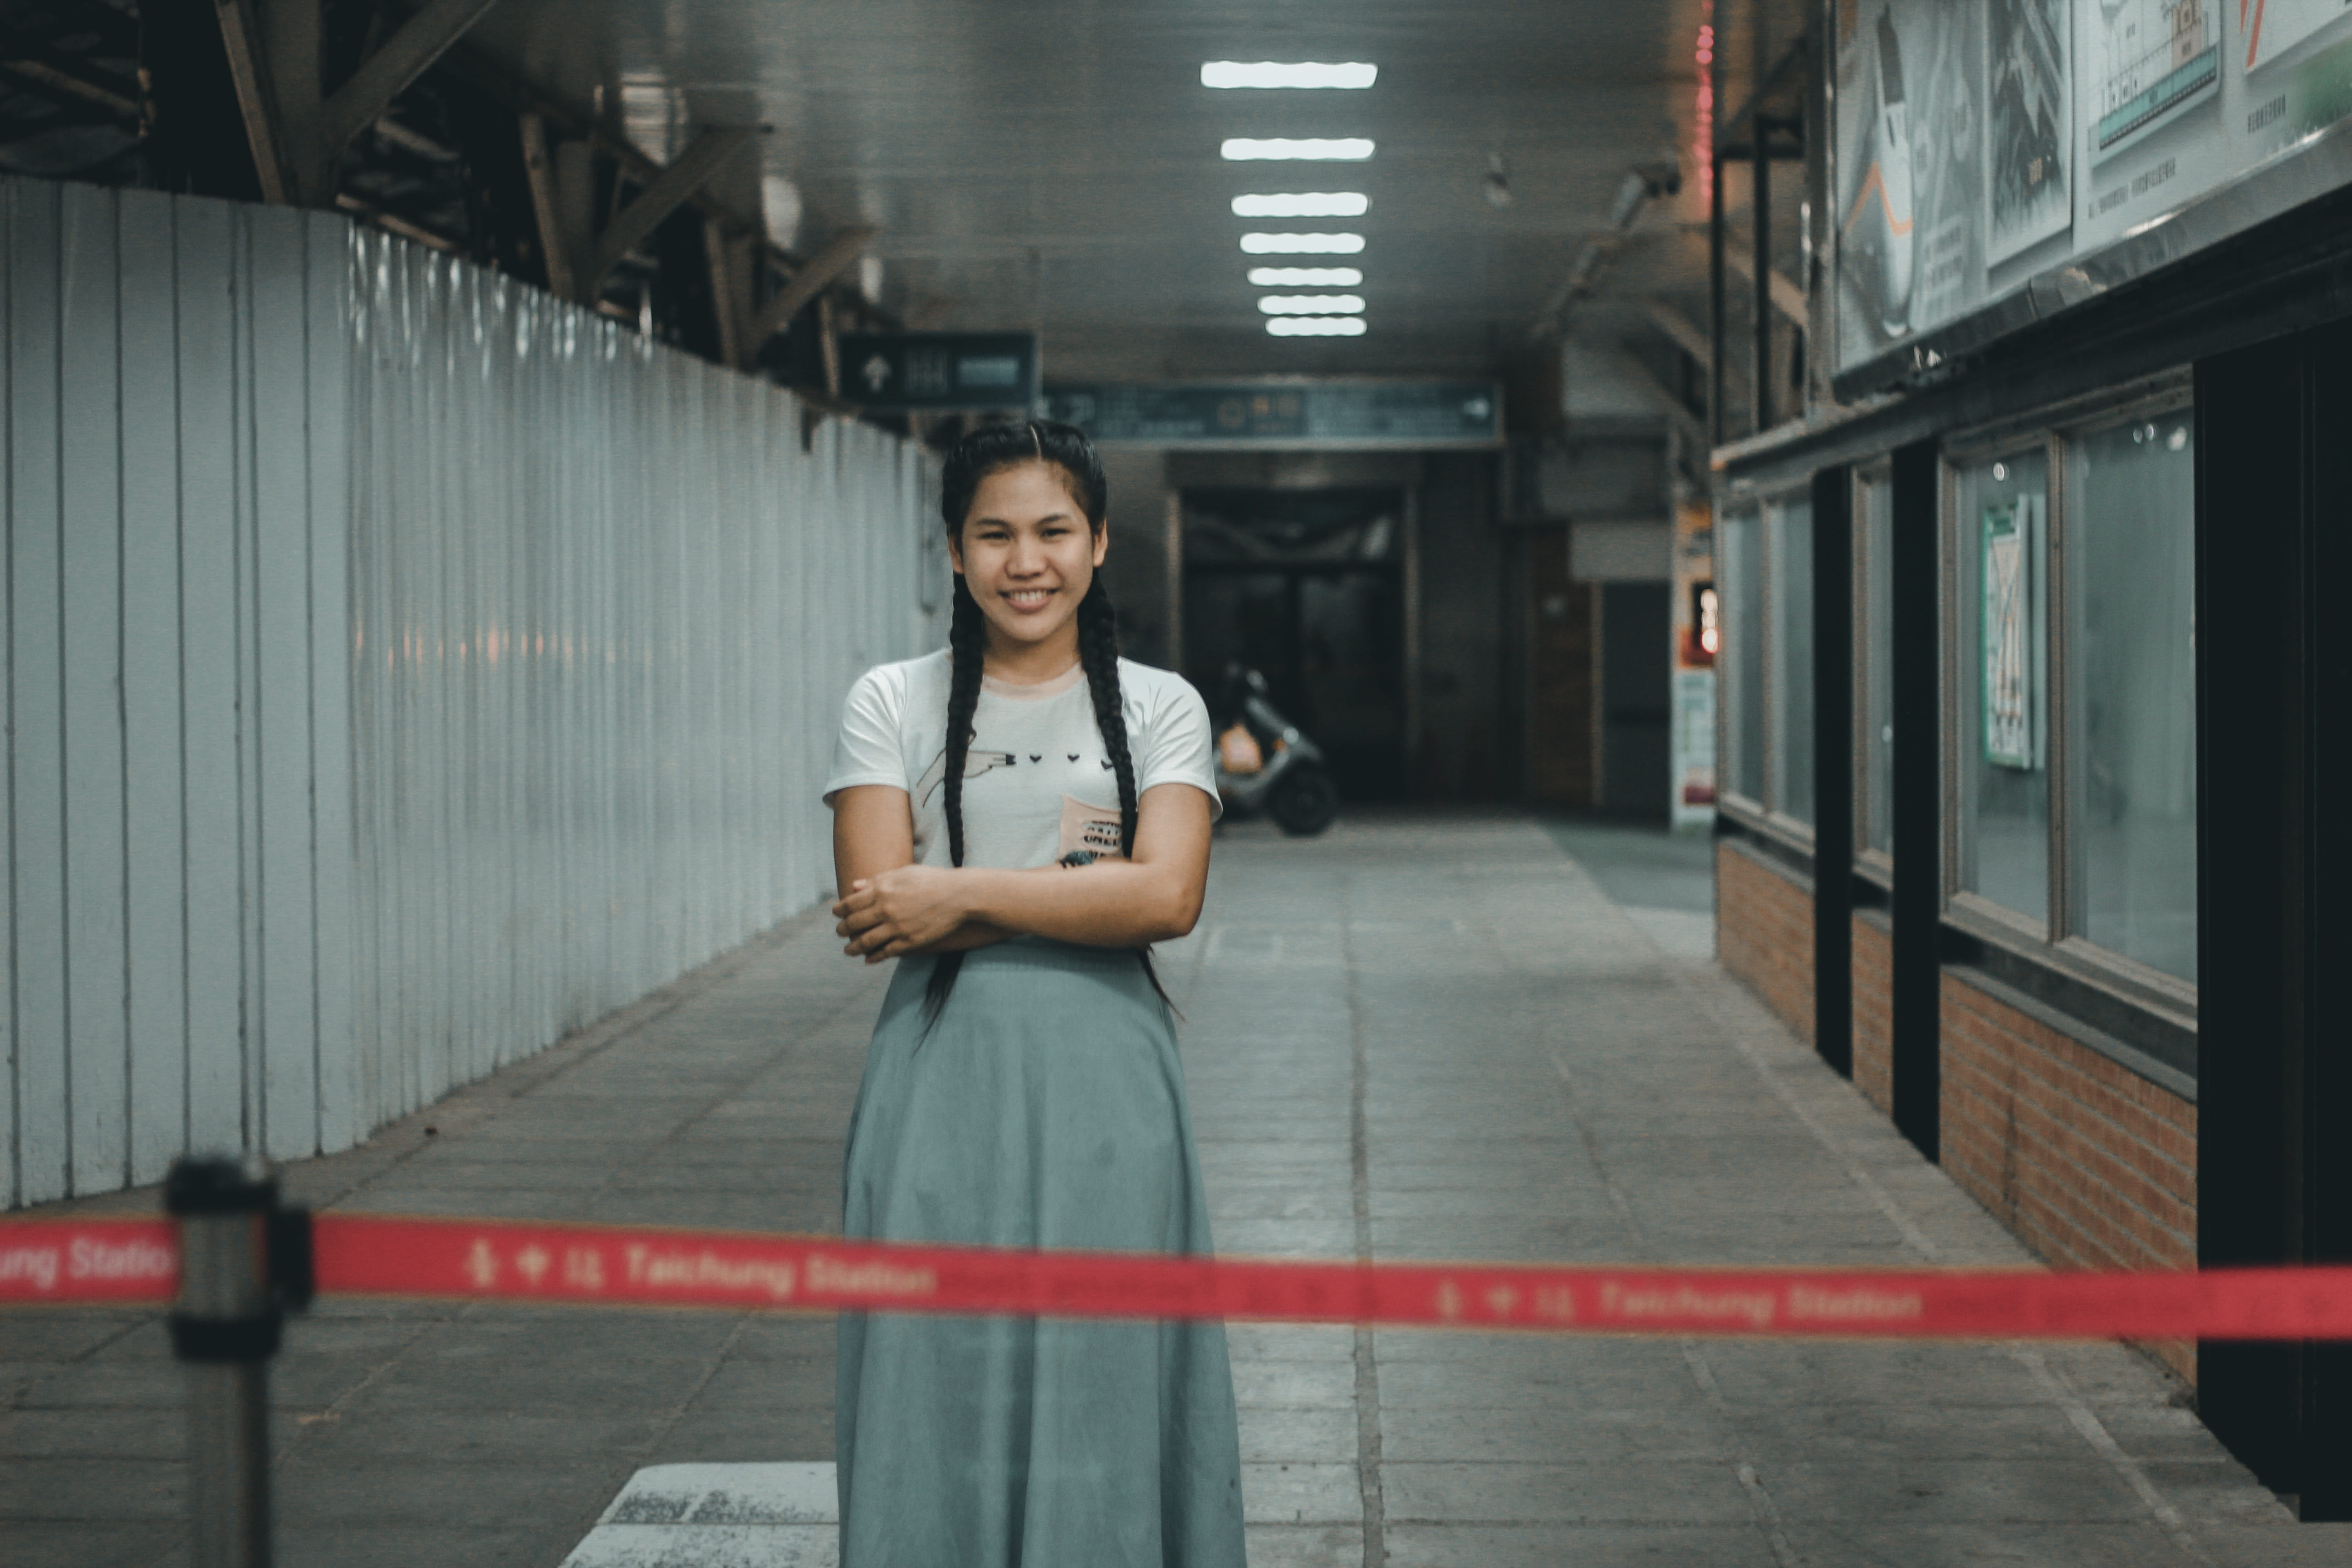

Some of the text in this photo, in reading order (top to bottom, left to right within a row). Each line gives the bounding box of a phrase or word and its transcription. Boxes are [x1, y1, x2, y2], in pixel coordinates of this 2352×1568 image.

[626, 1243, 795, 1300] Taichung
[804, 1254, 937, 1295] Station
[1600, 1282, 1774, 1328] Taichung
[1789, 1285, 1924, 1318] Station
